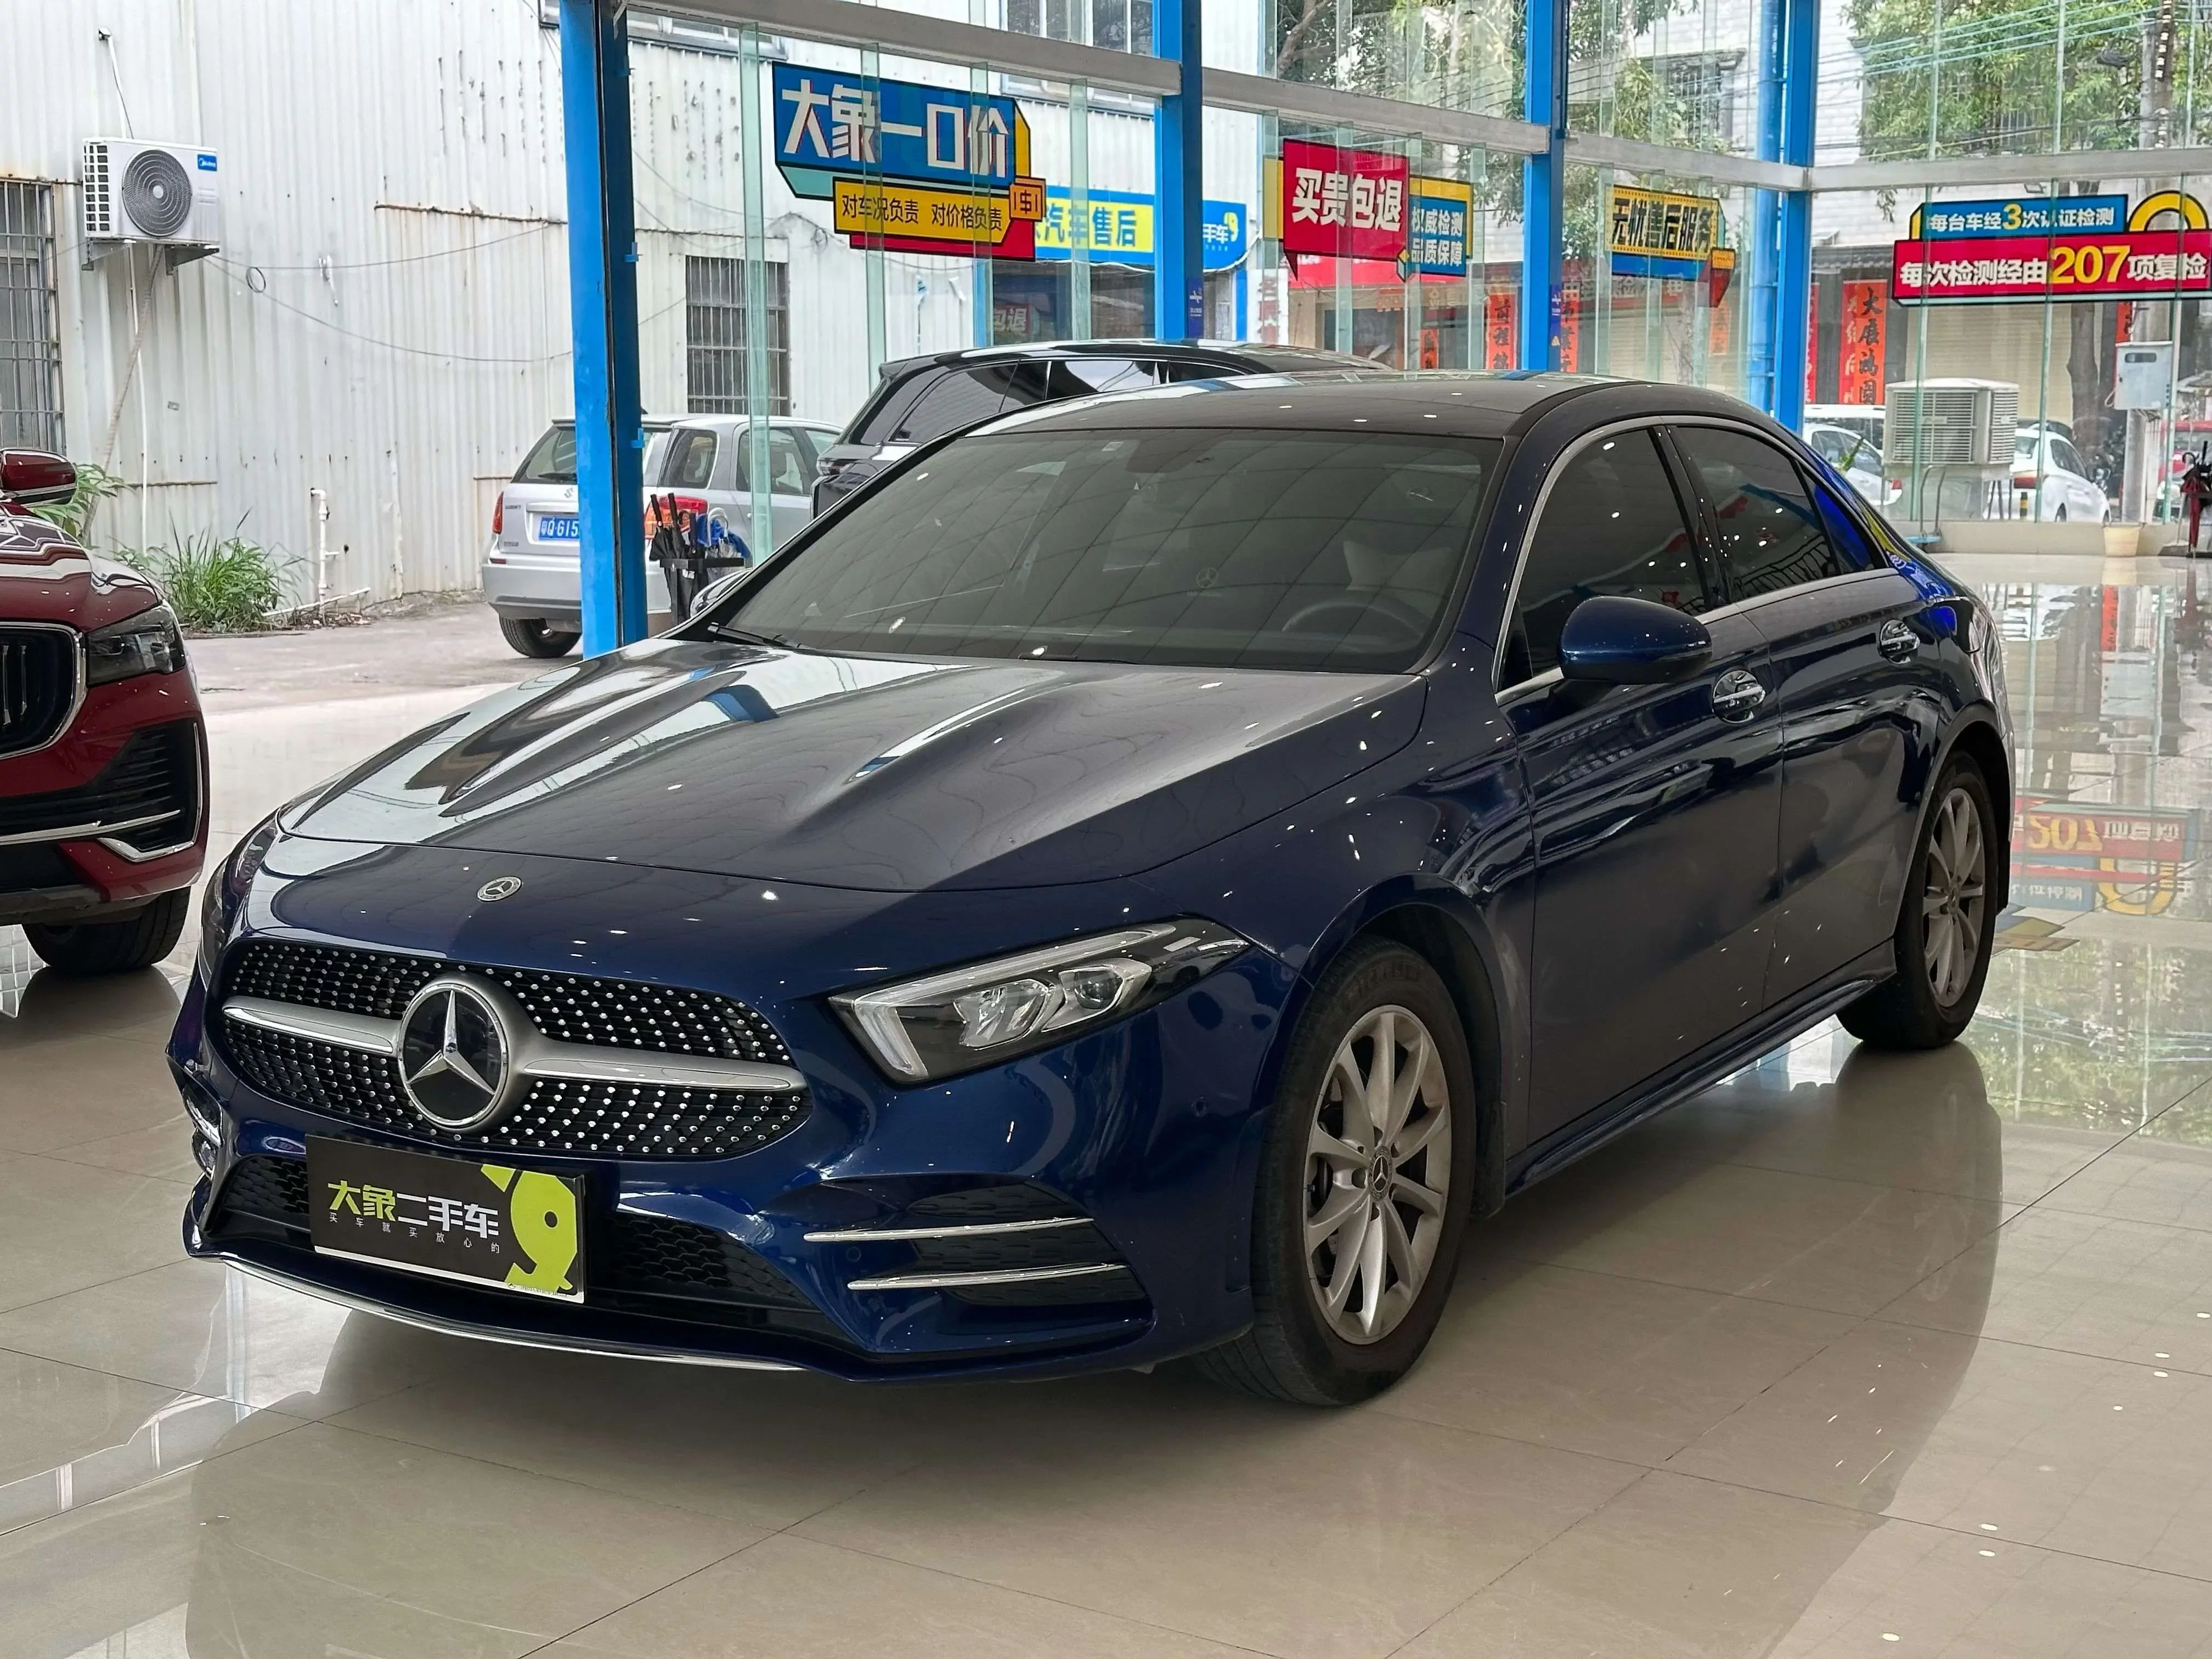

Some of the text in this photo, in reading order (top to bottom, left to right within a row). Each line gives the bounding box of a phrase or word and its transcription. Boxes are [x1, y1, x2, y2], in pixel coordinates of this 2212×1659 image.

[781, 78, 1009, 178] 大象一口价
[842, 193, 1002, 232] 对车况负责 对价格负责
[1291, 167, 1403, 232] 买贵包退
[1410, 237, 1463, 267] 品质保障
[1899, 244, 2208, 288] 每次检测经由207项复检
[328, 1180, 499, 1239] 大象二手车
[329, 1212, 500, 1254] 买车就买放心的
